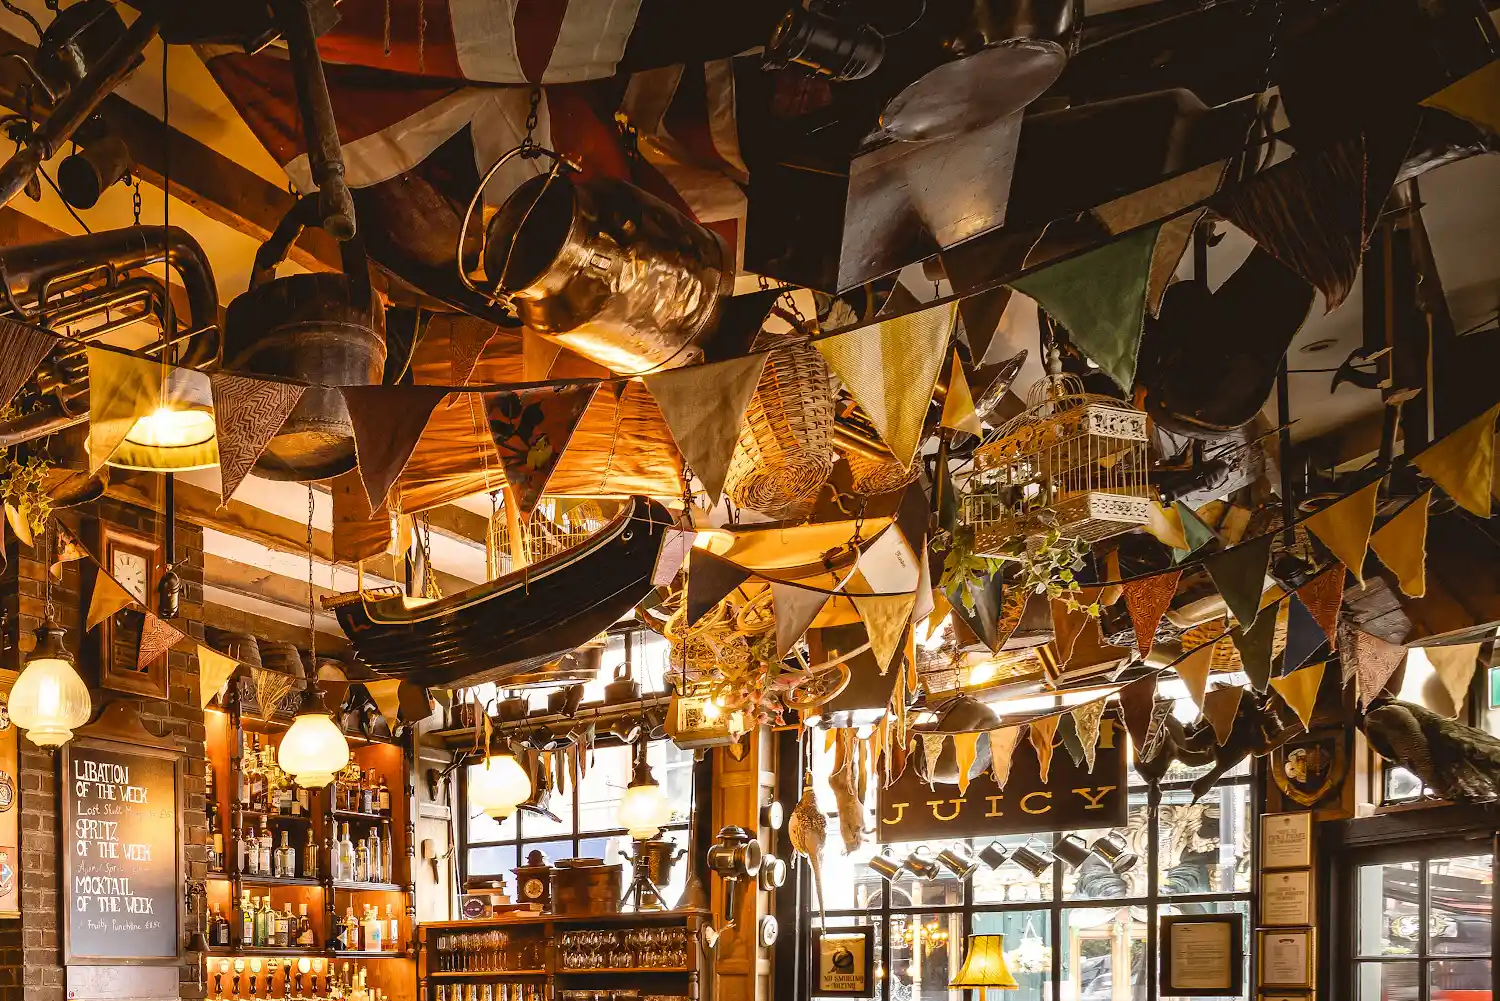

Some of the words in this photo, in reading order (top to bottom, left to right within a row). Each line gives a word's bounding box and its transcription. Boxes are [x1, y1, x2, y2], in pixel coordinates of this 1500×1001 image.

[74, 760, 129, 785] LIBATION
[75, 780, 91, 798] OF
[95, 782, 117, 801] THE
[119, 785, 149, 804] WEEK
[77, 800, 101, 816] Lost
[881, 785, 1117, 825] JUICY
[75, 818, 119, 842] SPRITZ
[76, 840, 92, 857] OF
[97, 841, 120, 859] THE
[122, 843, 153, 862] WEEK
[75, 875, 134, 896] MOCKTAIL
[76, 896, 92, 912] OF
[97, 896, 121, 913] THE
[124, 897, 154, 914] WEEK
